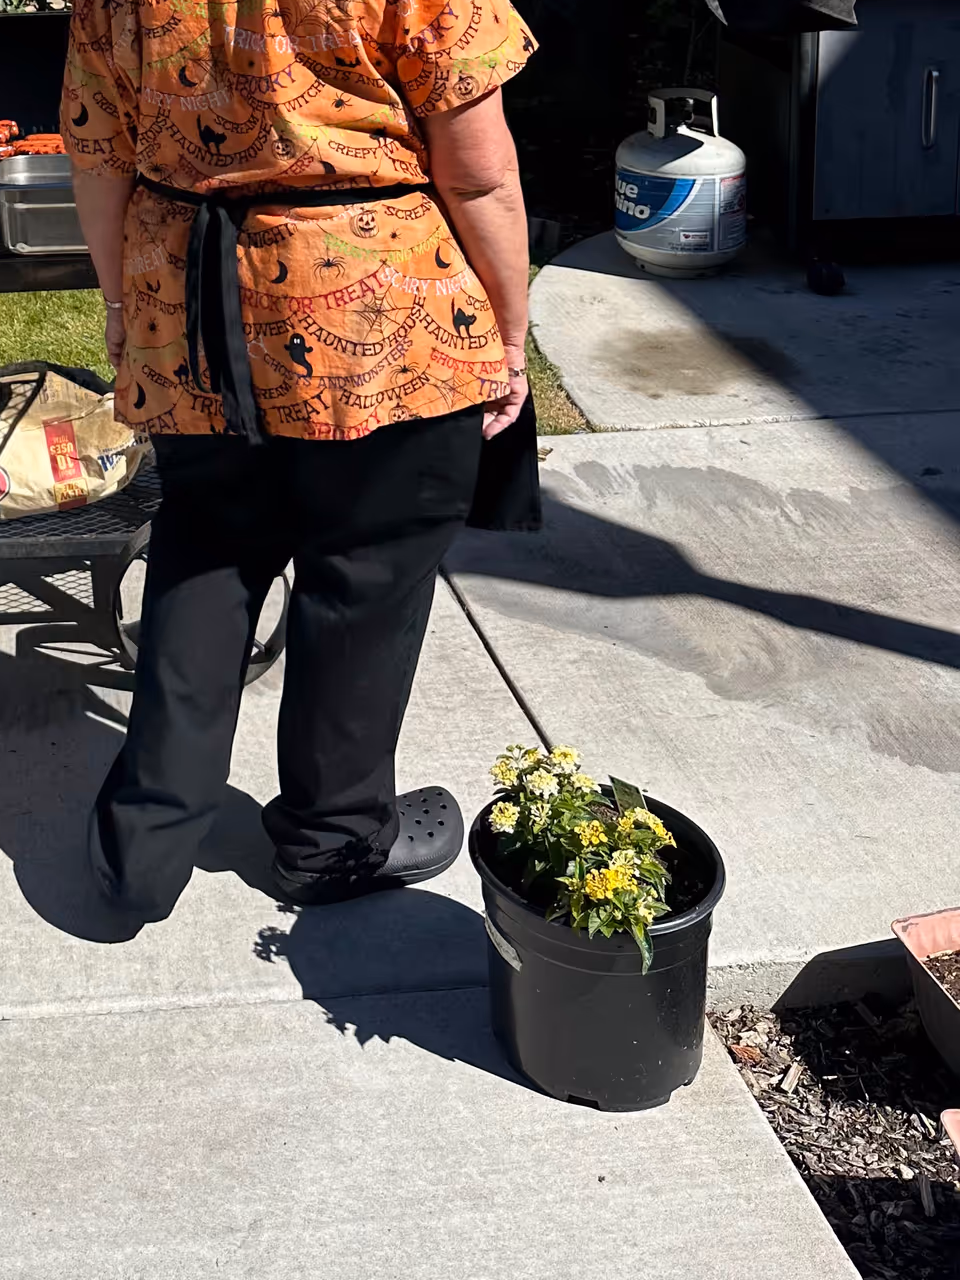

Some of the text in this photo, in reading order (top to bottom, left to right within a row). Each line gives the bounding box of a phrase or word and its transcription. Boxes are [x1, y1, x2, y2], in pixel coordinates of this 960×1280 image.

[456, 5, 482, 51] WITCH
[295, 52, 352, 81] GHOSTS
[180, 88, 231, 112] NIGHT
[283, 79, 326, 113] WITCH
[214, 111, 260, 134] SCREAM
[163, 121, 273, 168] HAUNTED HOUSE
[327, 140, 377, 160] CREEPY
[247, 222, 295, 249] NIGHT
[288, 297, 315, 315] OR
[321, 272, 385, 310] TREAT
[381, 267, 430, 296] SCARY
[299, 313, 383, 357] HAUNTED
[387, 294, 426, 347] HOUSE
[418, 310, 488, 350] HAUNTED
[350, 338, 413, 389] MONSTERS
[429, 349, 475, 374] GHOSTS
[338, 373, 431, 410] HALLOWEEN
[277, 393, 330, 424] TREAT
[49, 442, 74, 456] USES
[56, 454, 75, 470] 10
